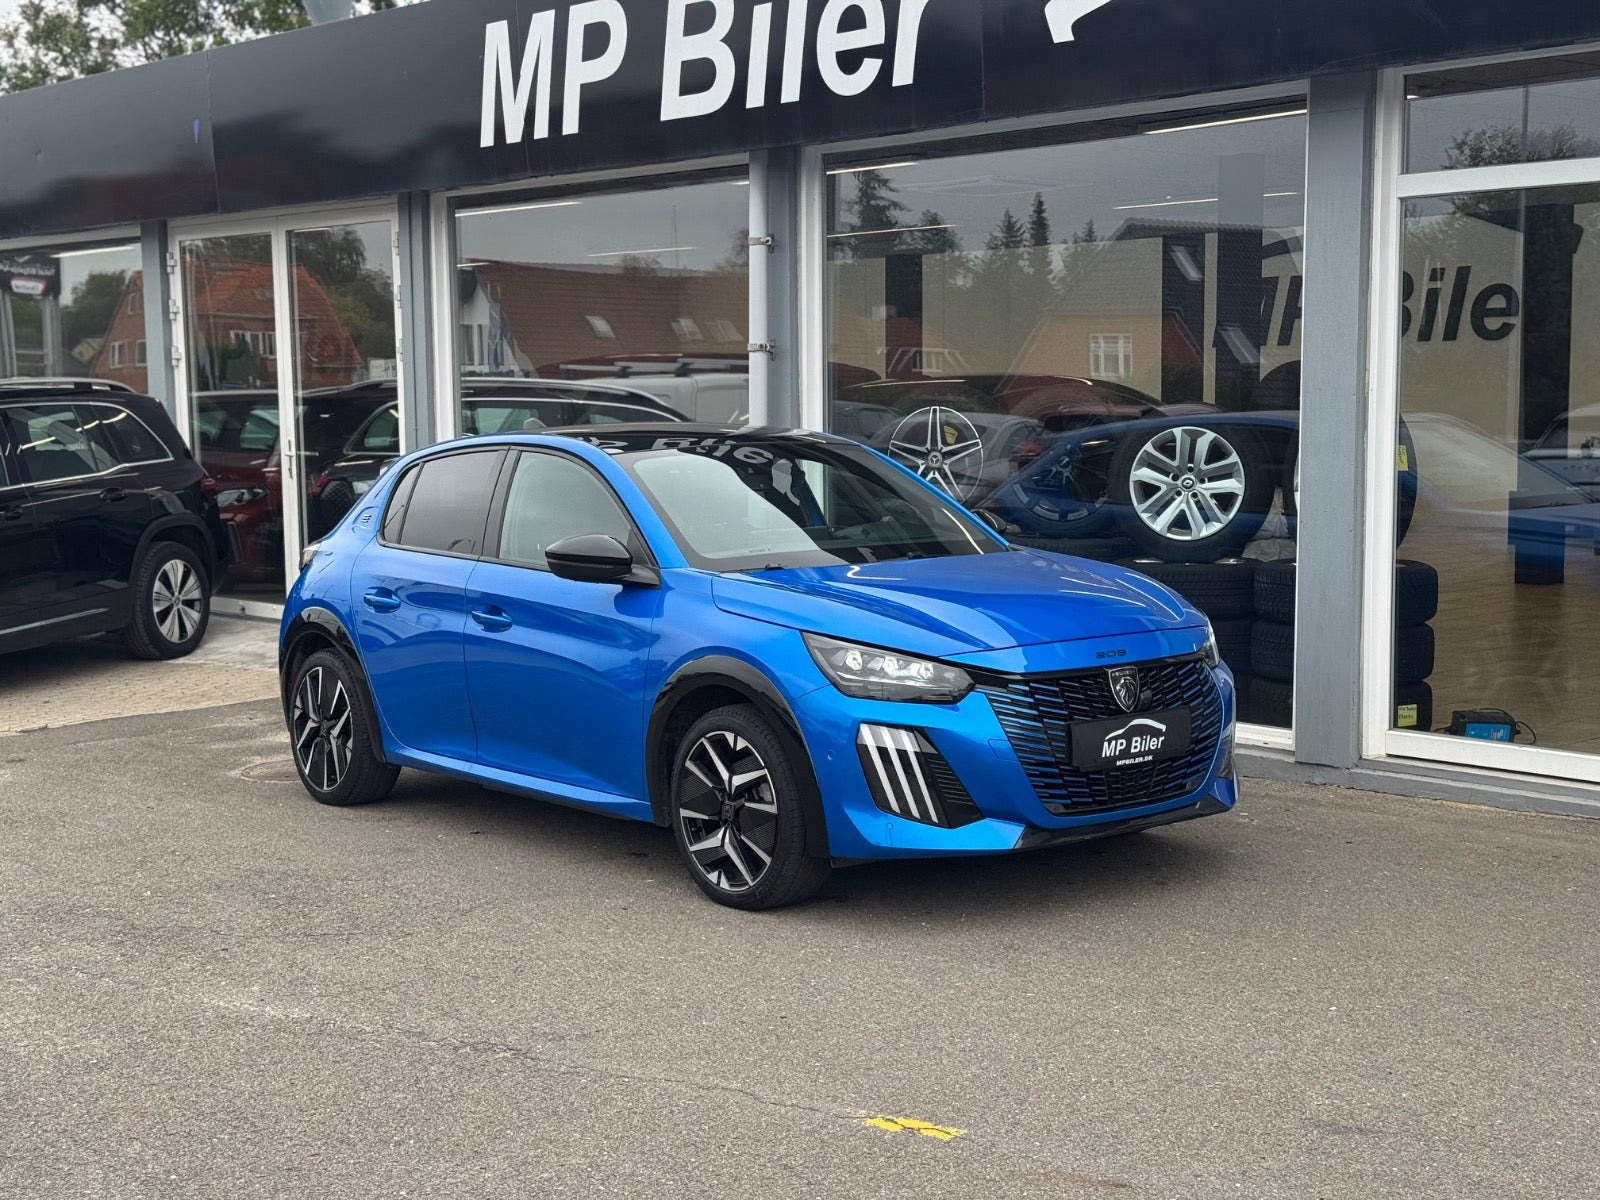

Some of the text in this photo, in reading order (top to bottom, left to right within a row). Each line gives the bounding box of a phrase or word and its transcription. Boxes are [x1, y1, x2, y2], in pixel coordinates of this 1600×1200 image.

[479, 0, 930, 148] MP Biler
[1101, 734, 1165, 758] MP Biler
[1115, 755, 1154, 766] MPBILER.DK
